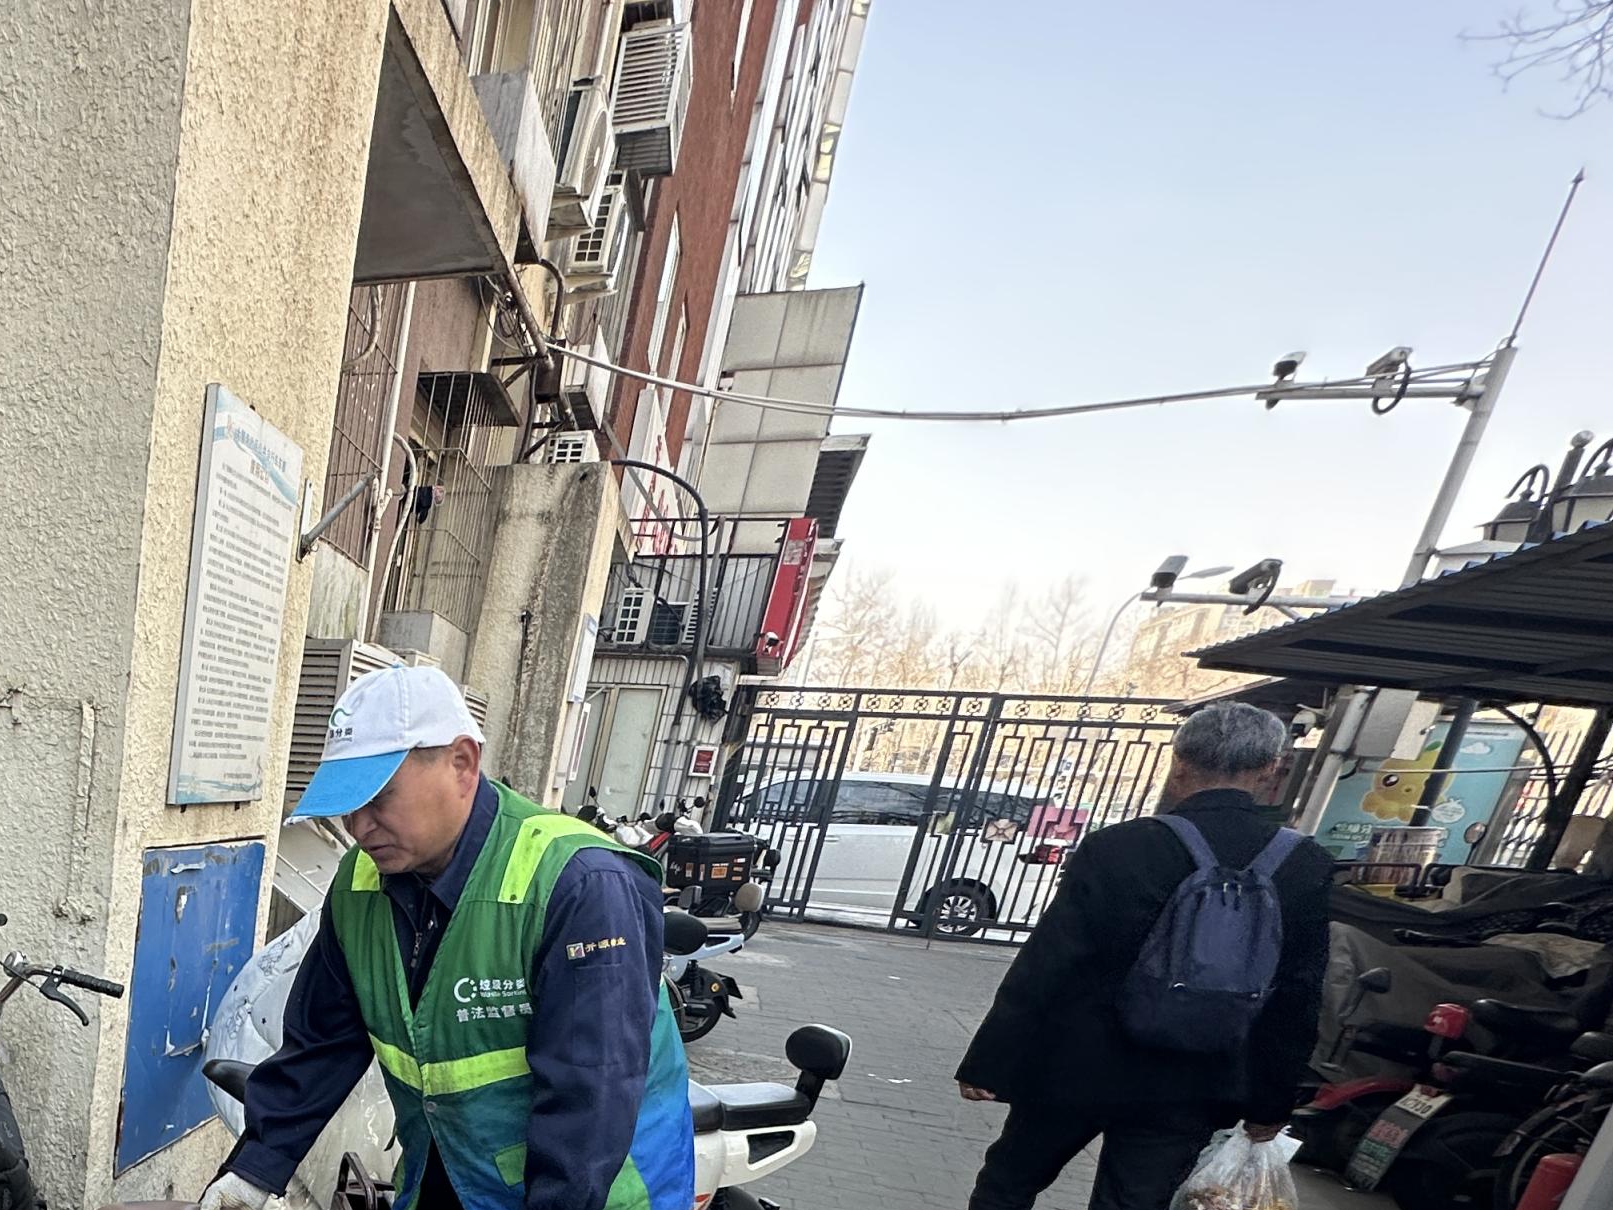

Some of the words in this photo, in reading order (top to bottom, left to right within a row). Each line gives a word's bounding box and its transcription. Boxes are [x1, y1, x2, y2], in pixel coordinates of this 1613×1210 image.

[456, 1002, 534, 1023] 普法监督员
